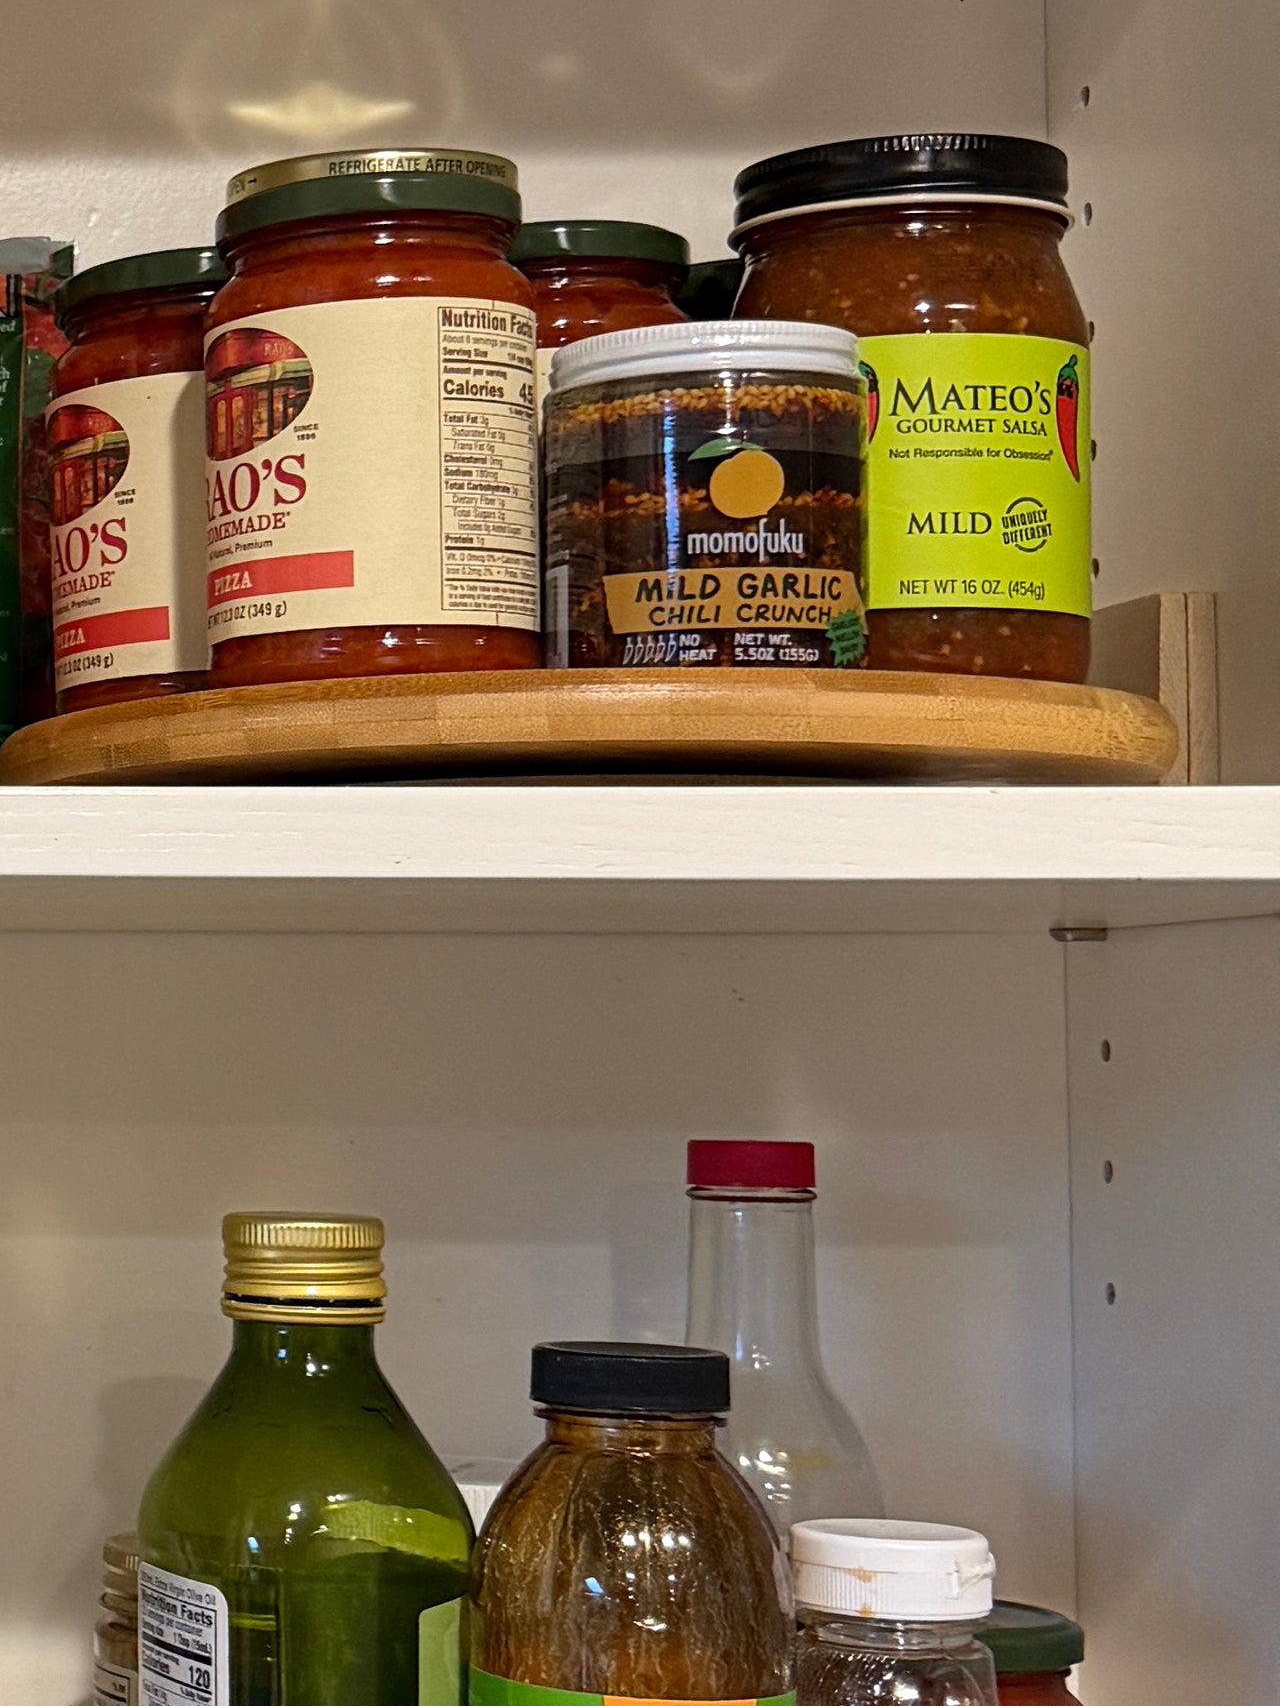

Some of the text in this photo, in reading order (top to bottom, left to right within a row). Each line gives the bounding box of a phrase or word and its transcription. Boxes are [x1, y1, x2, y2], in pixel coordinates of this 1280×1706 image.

[329, 158, 506, 178] REFRIGERATE AFTER OPENING
[442, 310, 532, 338] Nutrition Facts
[443, 379, 533, 404] Calories 45
[896, 419, 1047, 436] GOURMET SALSA
[889, 449, 910, 458] Not
[914, 449, 983, 459] Responsible
[987, 449, 1000, 457] for
[907, 511, 992, 535] MILD
[1001, 509, 1048, 529] UNIQUELY
[687, 518, 803, 563] momofuku
[1002, 524, 1052, 545] DIFFERENT
[54, 516, 128, 581] AO'S
[214, 571, 253, 596] PIZZA
[635, 573, 842, 602] MILD GARLIC
[899, 580, 1044, 600] NET WT 16 OZ. (454g)
[248, 601, 287, 619] (349 g)
[649, 604, 831, 627] CHILI CRUNCH
[679, 634, 700, 646] NO
[734, 633, 792, 645] NET WT.
[679, 649, 717, 661] HEAT
[734, 648, 819, 661] 5.5OZ (155G)
[181, 1604, 213, 1626] Facts
[189, 1665, 211, 1690] 120
